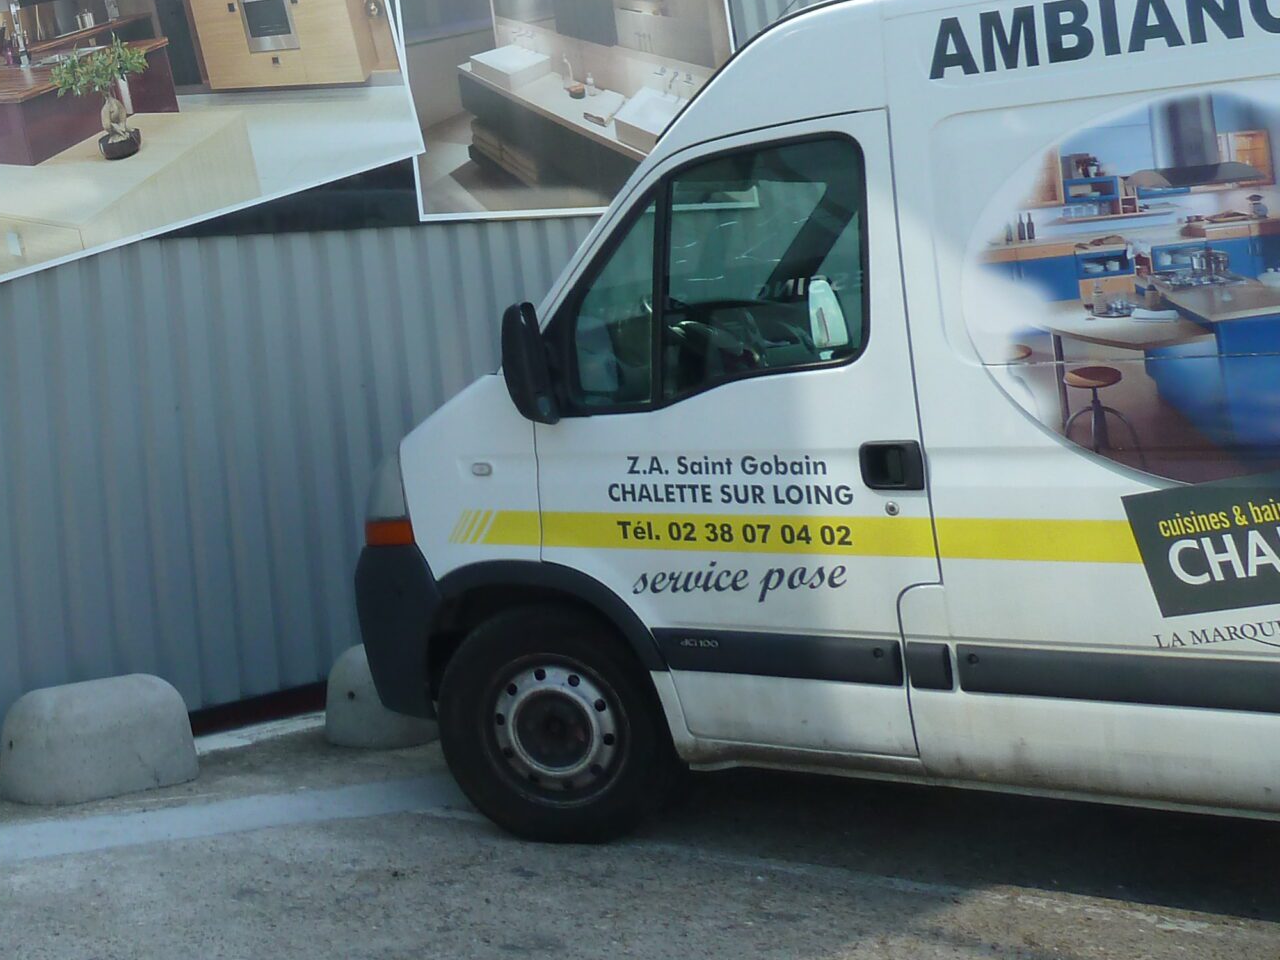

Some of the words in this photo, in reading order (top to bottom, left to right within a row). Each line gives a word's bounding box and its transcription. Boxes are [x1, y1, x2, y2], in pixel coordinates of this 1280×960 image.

[627, 456, 670, 475] Z.A.
[677, 455, 733, 475] Saint
[741, 455, 827, 475] Gobain
[608, 483, 713, 503] CHALETTE
[721, 484, 766, 504] SUR
[774, 485, 854, 505] LOING
[617, 520, 661, 540] Tél.
[668, 522, 697, 541] 02
[704, 523, 734, 542] 38
[742, 524, 770, 543] 07
[780, 525, 812, 545] 04
[820, 526, 852, 546] 02
[1158, 510, 1230, 537] cuisines
[1232, 505, 1248, 526] &
[1169, 526, 1280, 585] CHA
[633, 561, 749, 594] service
[758, 565, 848, 603] pose
[1153, 633, 1186, 649] LA
